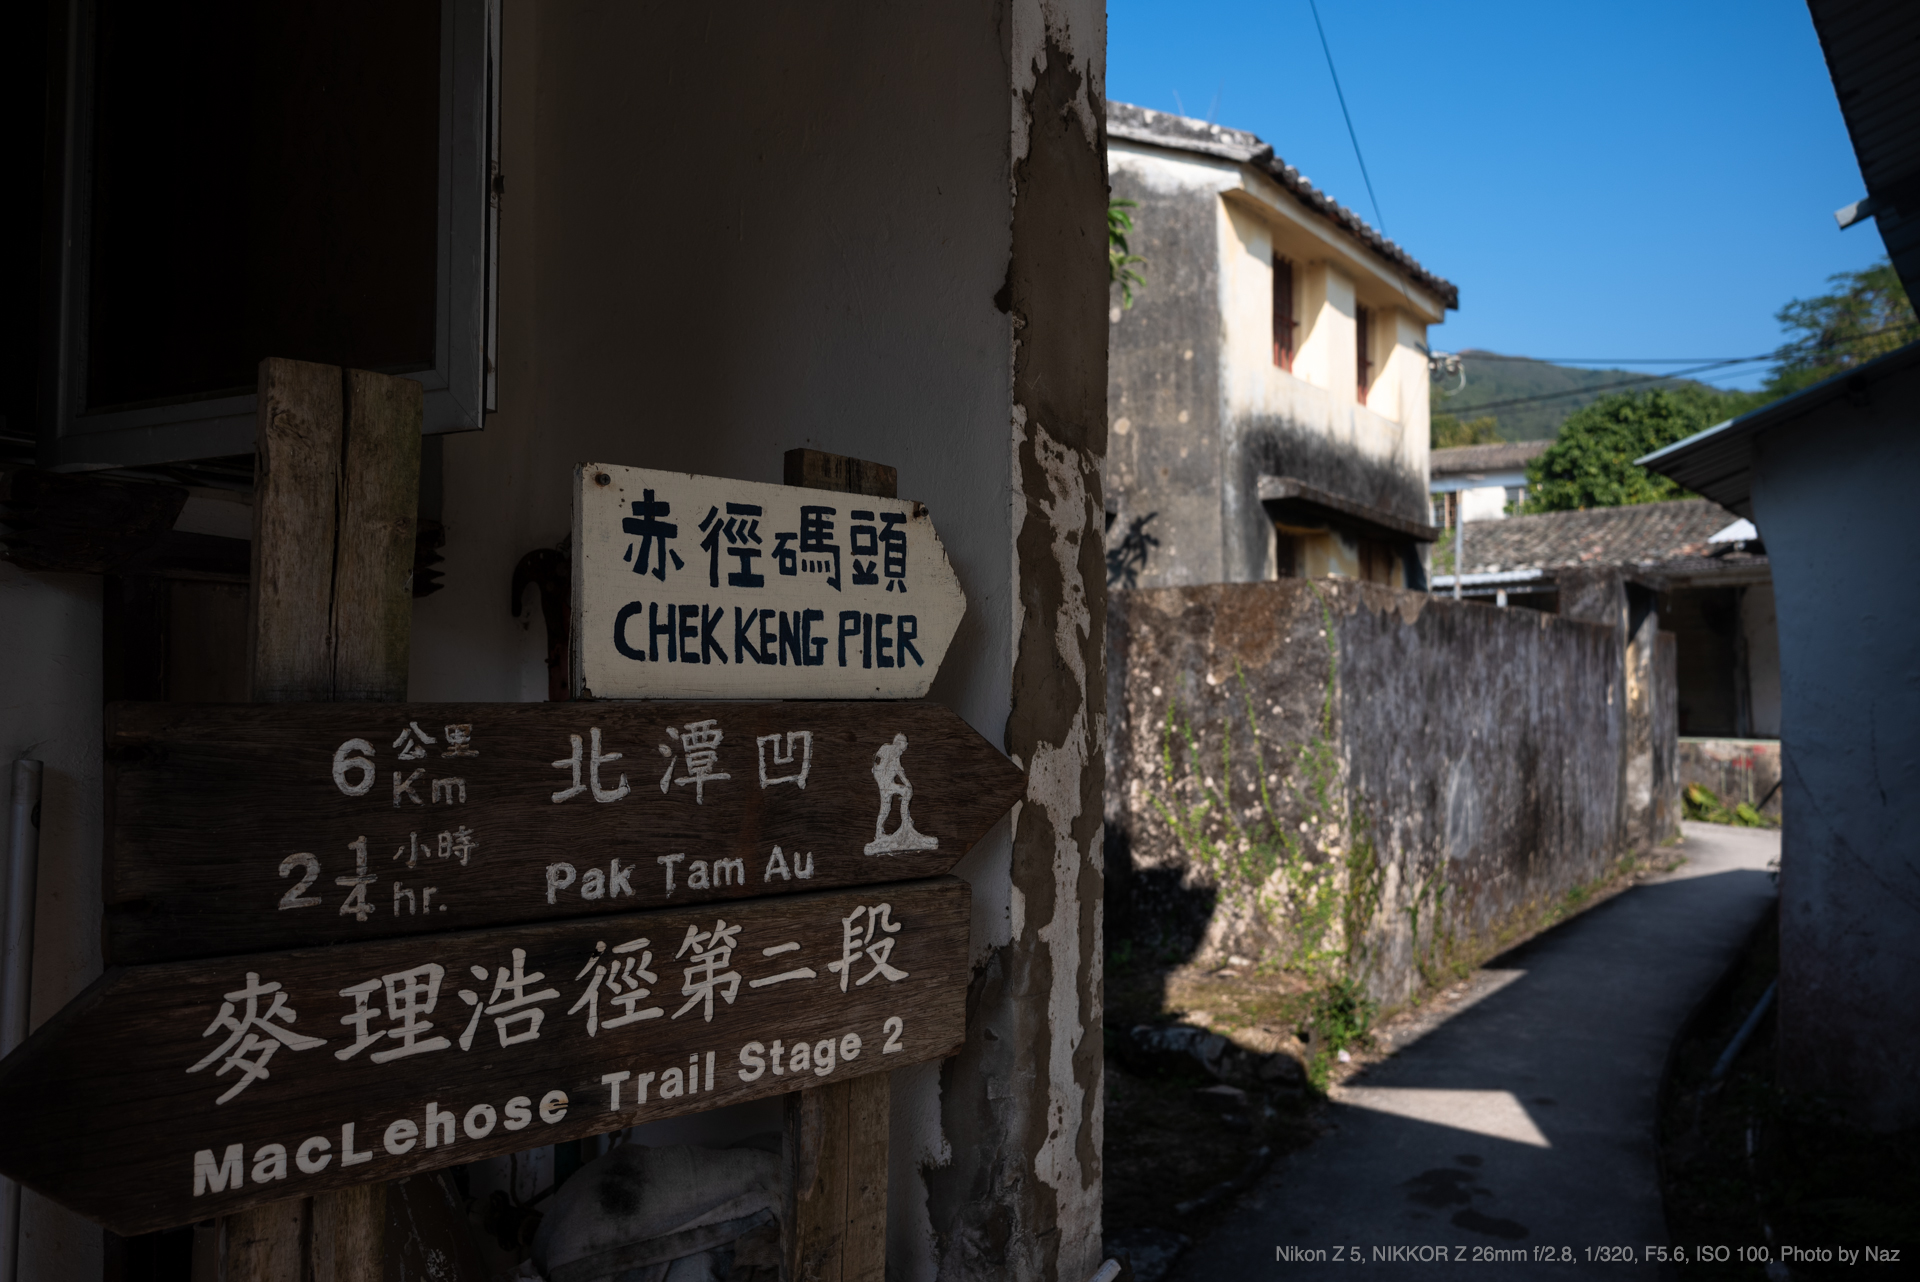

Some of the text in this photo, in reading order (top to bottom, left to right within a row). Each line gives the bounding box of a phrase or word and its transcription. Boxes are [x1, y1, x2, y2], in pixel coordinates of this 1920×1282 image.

[622, 488, 907, 593] 赤徑碼頭
[614, 601, 925, 668] CHEK KENG PIER
[332, 738, 376, 797] 6
[392, 721, 480, 760] 公里
[551, 719, 814, 805] 北潭凹
[392, 768, 467, 808] Km
[392, 825, 479, 868] 小時
[546, 845, 815, 905] Pak Tam Au
[278, 852, 322, 911] 2
[393, 881, 447, 917] hr.
[185, 902, 910, 1106] 麥理浩徑第二段
[193, 1016, 904, 1197] MacLehose Trail Stage 2
